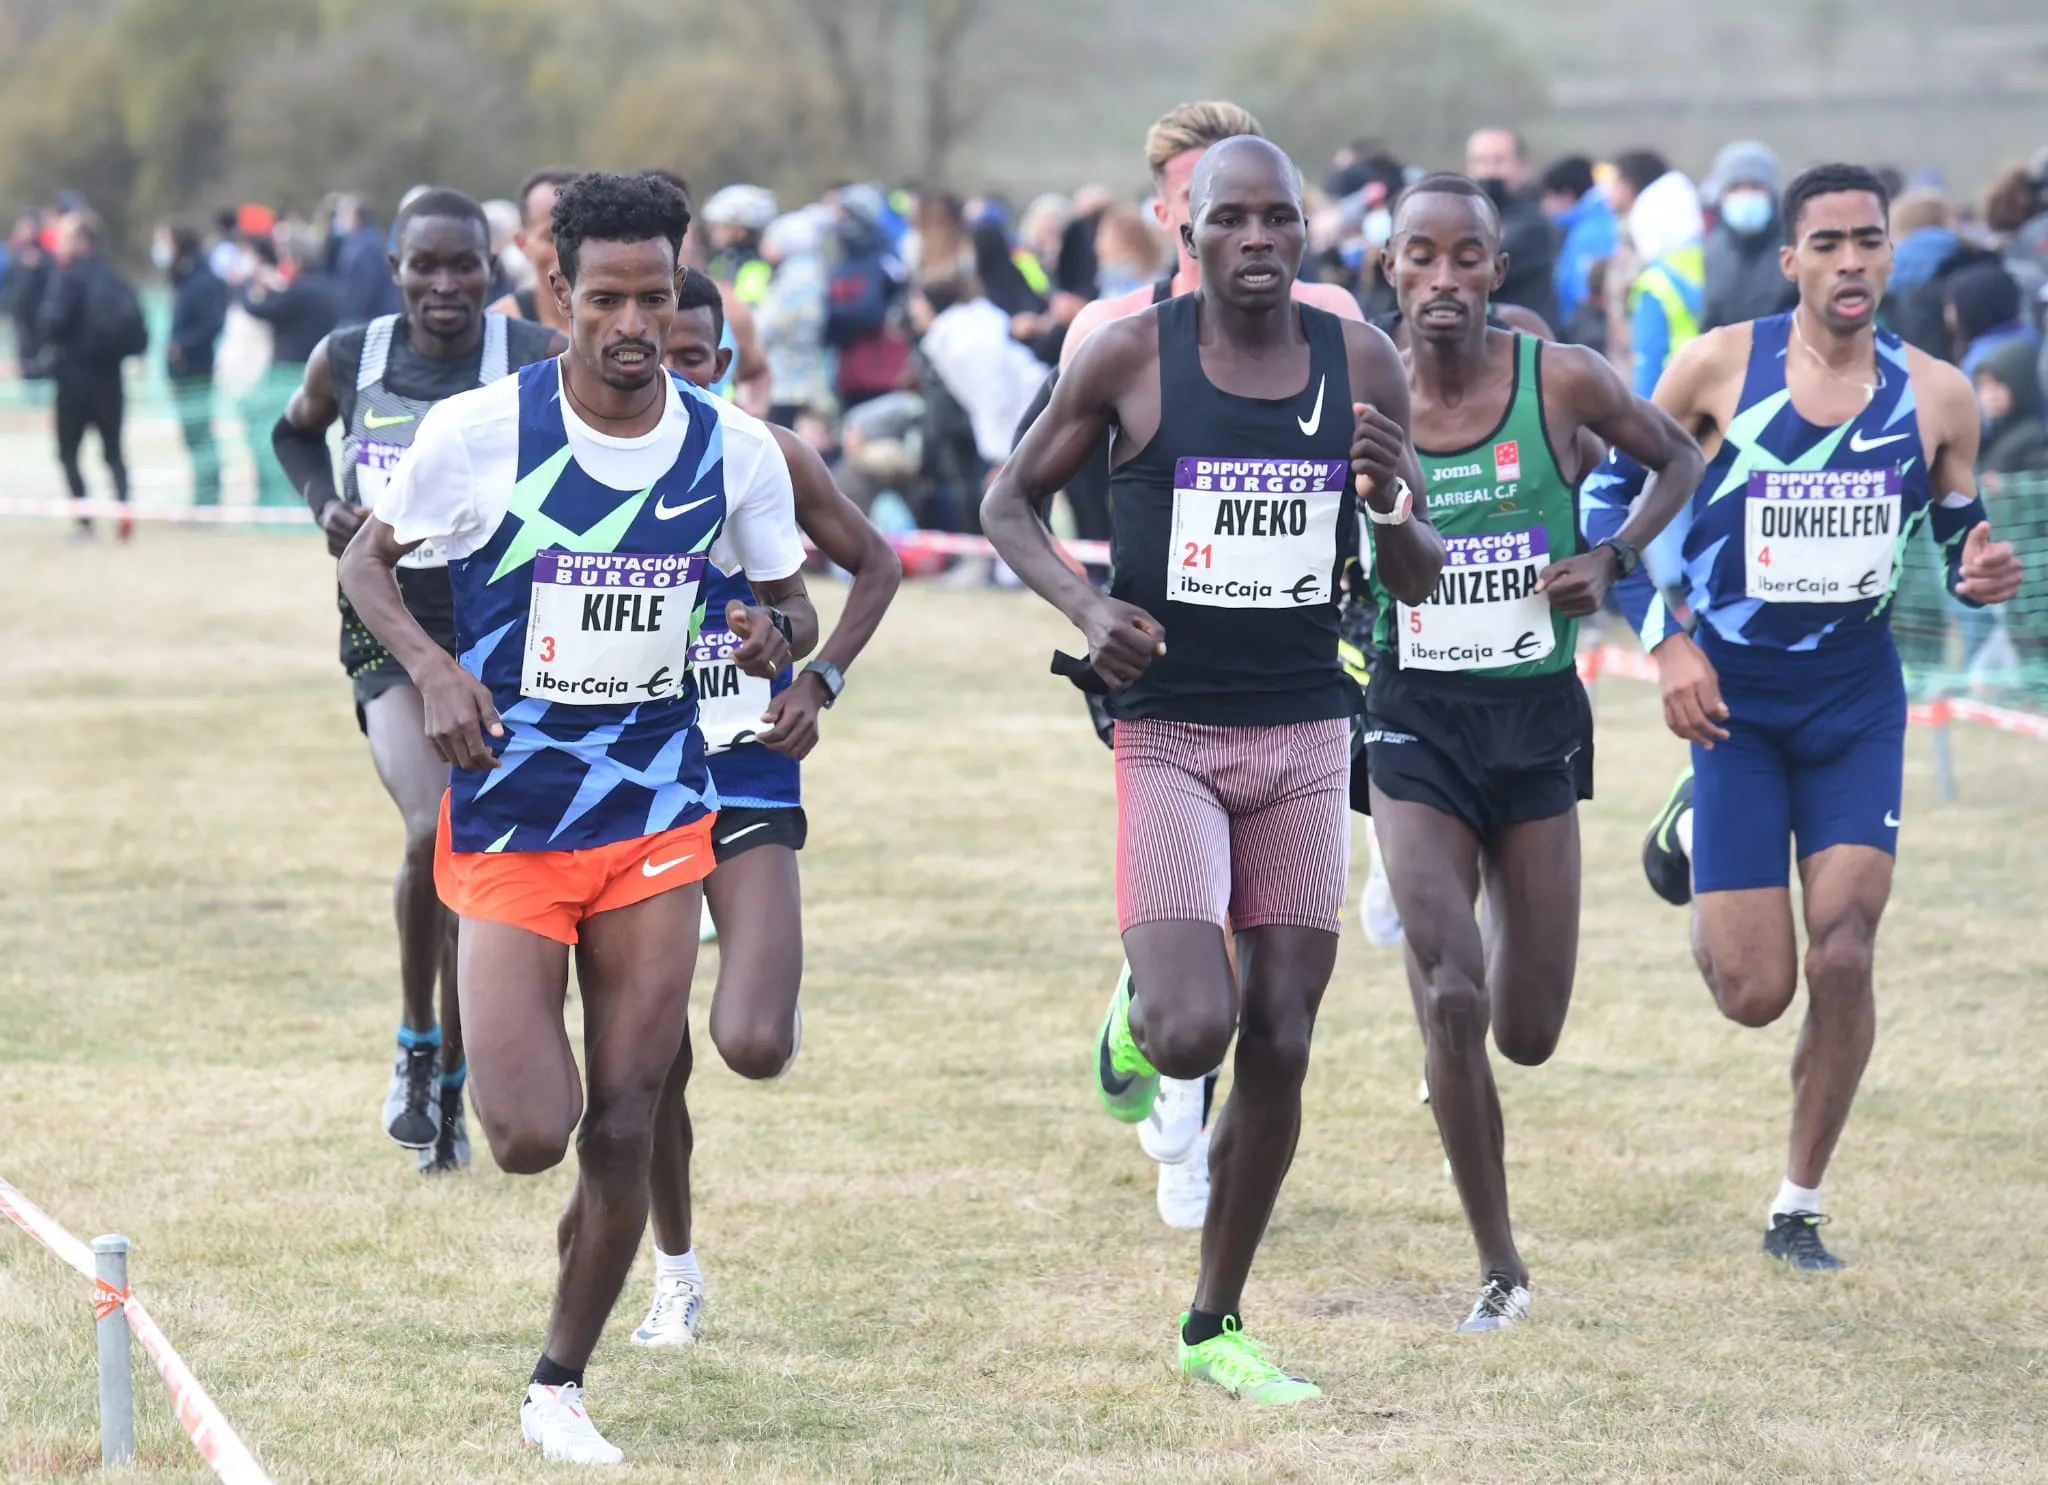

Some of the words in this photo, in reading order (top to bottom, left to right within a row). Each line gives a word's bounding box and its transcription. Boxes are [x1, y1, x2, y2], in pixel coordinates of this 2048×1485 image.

[1196, 461, 1328, 477] DIPUTACIÓN
[1766, 469, 1886, 485] DIPUTACIÓN
[1195, 476, 1326, 492] BURGOS
[1766, 484, 1885, 499] BURGOS
[1426, 488, 1492, 507] LARREAL
[1214, 499, 1307, 536] AYEKO
[1761, 503, 1891, 538] OUKHELFEN
[1443, 532, 1530, 551] UTACIÓN
[557, 554, 691, 571] DIPUTACIÓN
[1183, 542, 1212, 569] 21
[1450, 544, 1532, 565] RGOS
[1757, 546, 1771, 567] 4
[555, 569, 688, 586] BURGOS
[1424, 564, 1539, 605] WIZERA
[1758, 575, 1839, 596] iberCaja
[1181, 576, 1272, 601] iberCaja
[581, 593, 665, 632] KIFLE
[1411, 611, 1422, 634] 5
[539, 636, 555, 662] 3
[1411, 643, 1493, 662] iberCaja
[536, 672, 628, 698] iberCaja
